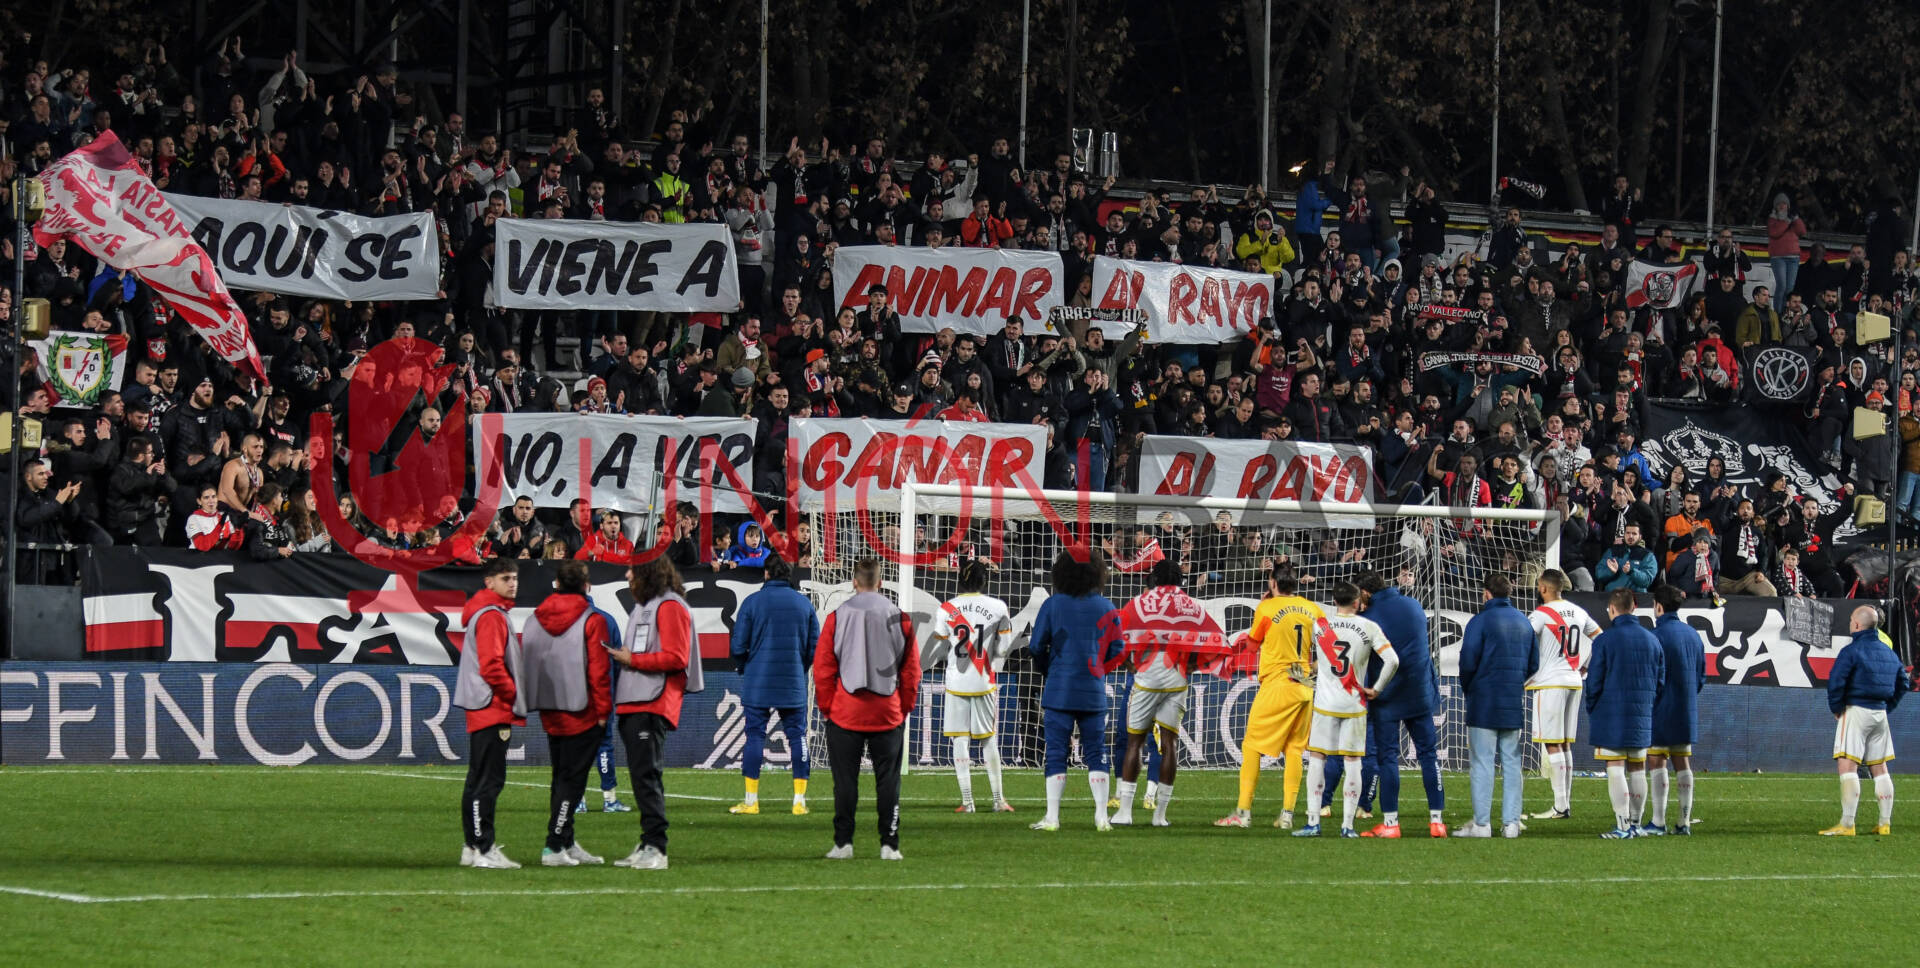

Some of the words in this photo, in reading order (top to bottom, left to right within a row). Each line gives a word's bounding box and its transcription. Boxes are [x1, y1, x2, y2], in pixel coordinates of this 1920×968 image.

[194, 210, 341, 281] AQUÍ
[338, 225, 421, 283] SE
[507, 239, 672, 296] VIENE
[676, 240, 728, 298] A
[843, 264, 1053, 320] ANIMAR
[1168, 273, 1270, 328] RAYO
[1408, 302, 1430, 313] RAYO
[1432, 307, 1482, 319] VALLECANO
[486, 431, 567, 497] NO,
[590, 432, 638, 489] A
[654, 432, 754, 490] VER
[802, 431, 1034, 492] GANAR
[1155, 451, 1216, 498] AL
[1237, 453, 1368, 503] RAYO
[975, 605, 993, 621] CISS
[953, 624, 984, 658] 21
[1294, 624, 1303, 658] 1
[1331, 640, 1351, 678] 3
[1559, 624, 1581, 657] 10
[472, 800, 482, 837] umbro
[554, 800, 570, 835] umbro
